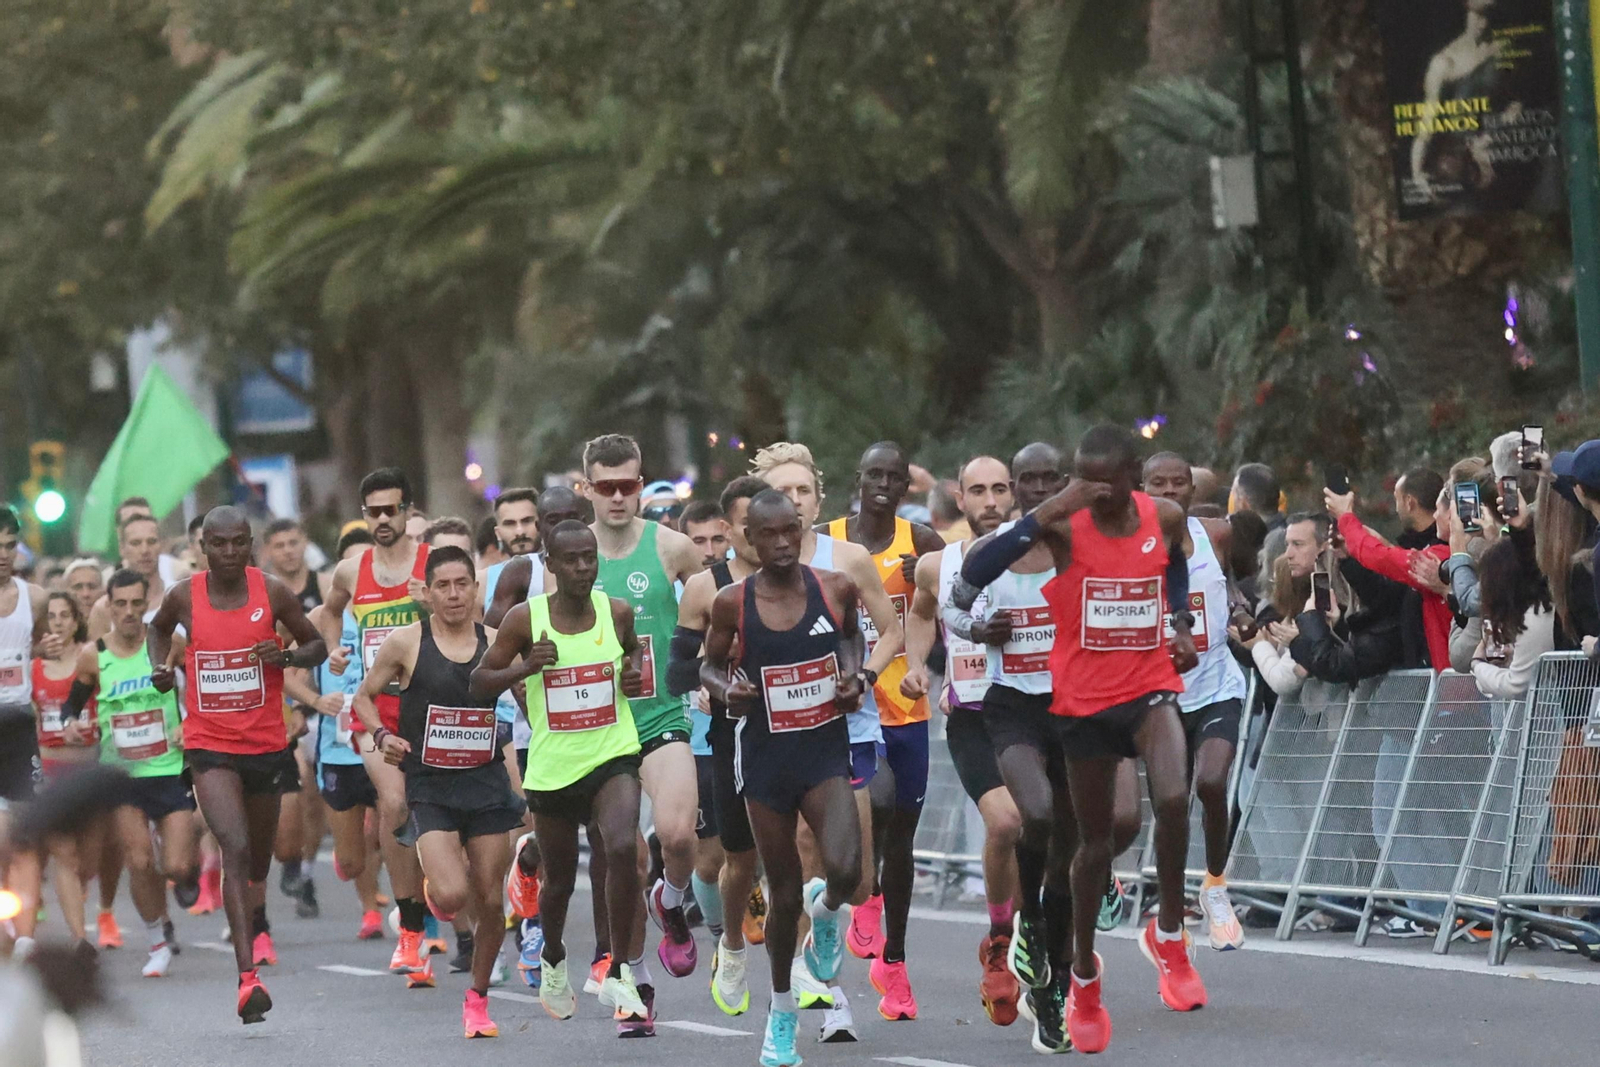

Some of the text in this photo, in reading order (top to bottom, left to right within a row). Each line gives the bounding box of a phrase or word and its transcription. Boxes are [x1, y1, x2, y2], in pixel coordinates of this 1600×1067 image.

[1396, 116, 1480, 136] HUMANOS
[1094, 604, 1151, 617] KIPSIRAT
[201, 671, 257, 684] MBURUGU
[574, 688, 589, 700] 16
[787, 684, 822, 700] MITEI
[429, 729, 491, 741] AMBROCIO
